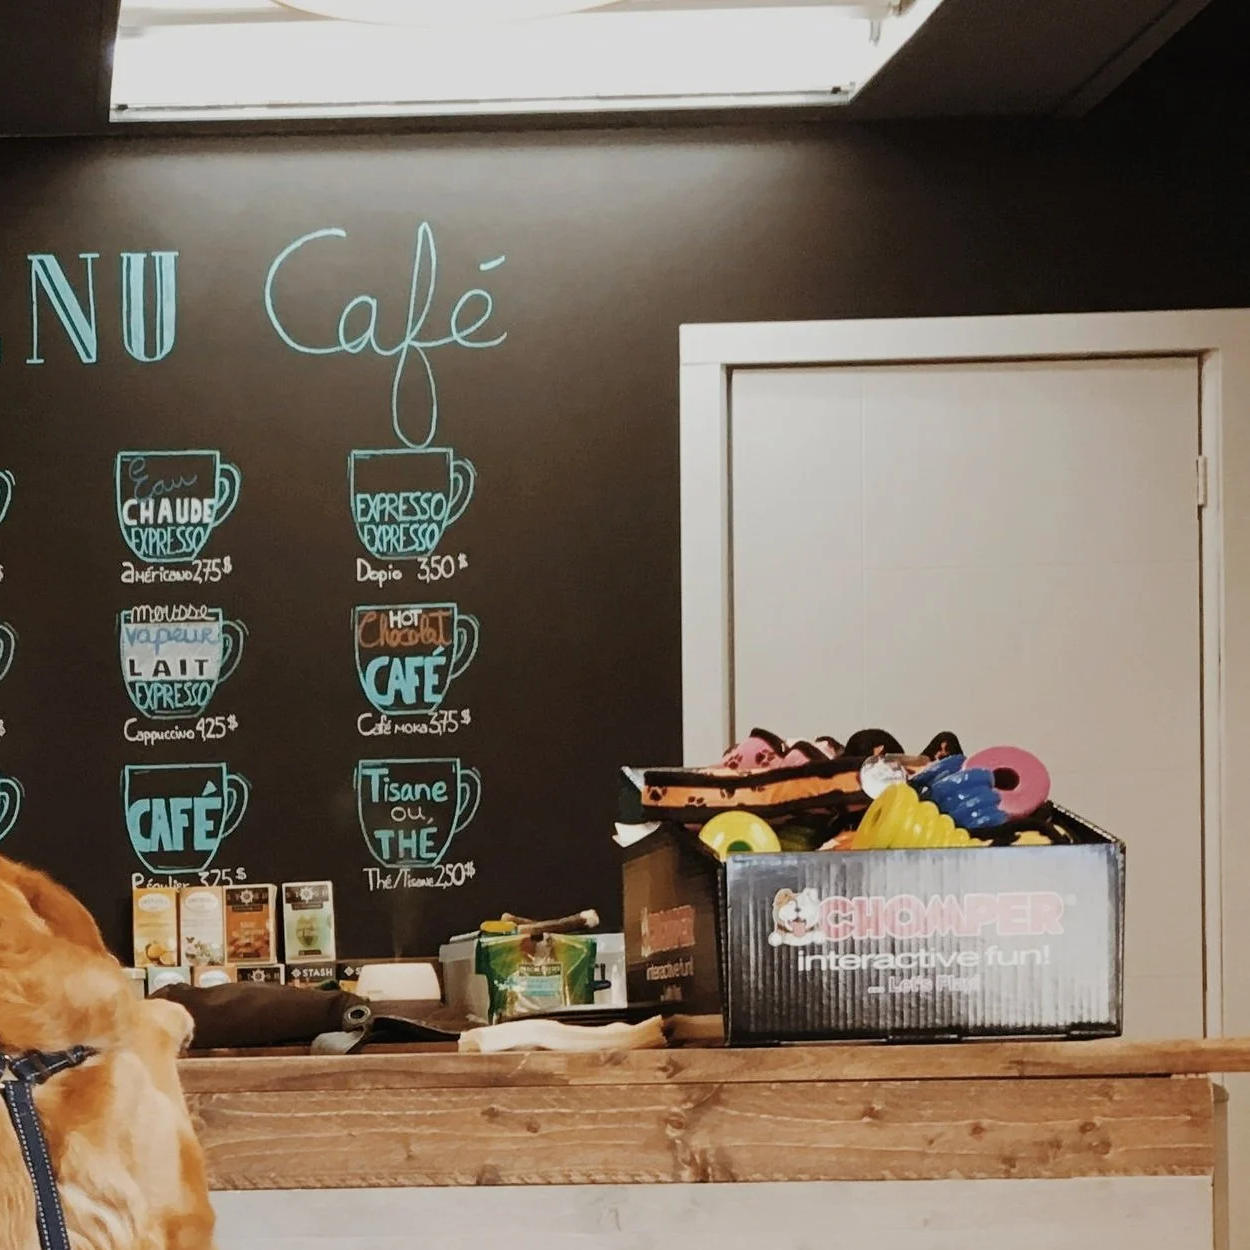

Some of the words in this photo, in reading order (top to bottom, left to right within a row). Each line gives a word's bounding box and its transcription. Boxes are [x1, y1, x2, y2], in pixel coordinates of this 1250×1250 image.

[265, 222, 507, 449] Café
[128, 457, 198, 500] Eau
[122, 498, 217, 526] CHAUDE
[356, 492, 446, 522] EXPRESSO
[131, 527, 205, 556] EXPRESSO
[364, 522, 439, 552] EXPRESSO
[356, 558, 403, 598] Dopio
[131, 603, 217, 623] mousse
[389, 609, 422, 628] HOT
[129, 659, 209, 677] LAIT
[365, 645, 446, 706] CAFÉ
[135, 682, 211, 710] EXPRESSO
[124, 717, 195, 746] Cappuccino
[357, 713, 392, 736] Café
[362, 768, 448, 803] Tisane
[128, 780, 222, 852] CAFÉ
[391, 806, 426, 821] ou
[818, 890, 1064, 941] CHOMPER
[302, 967, 333, 977] STASH
[799, 947, 980, 971] interactive
[984, 945, 1052, 966] fun!
